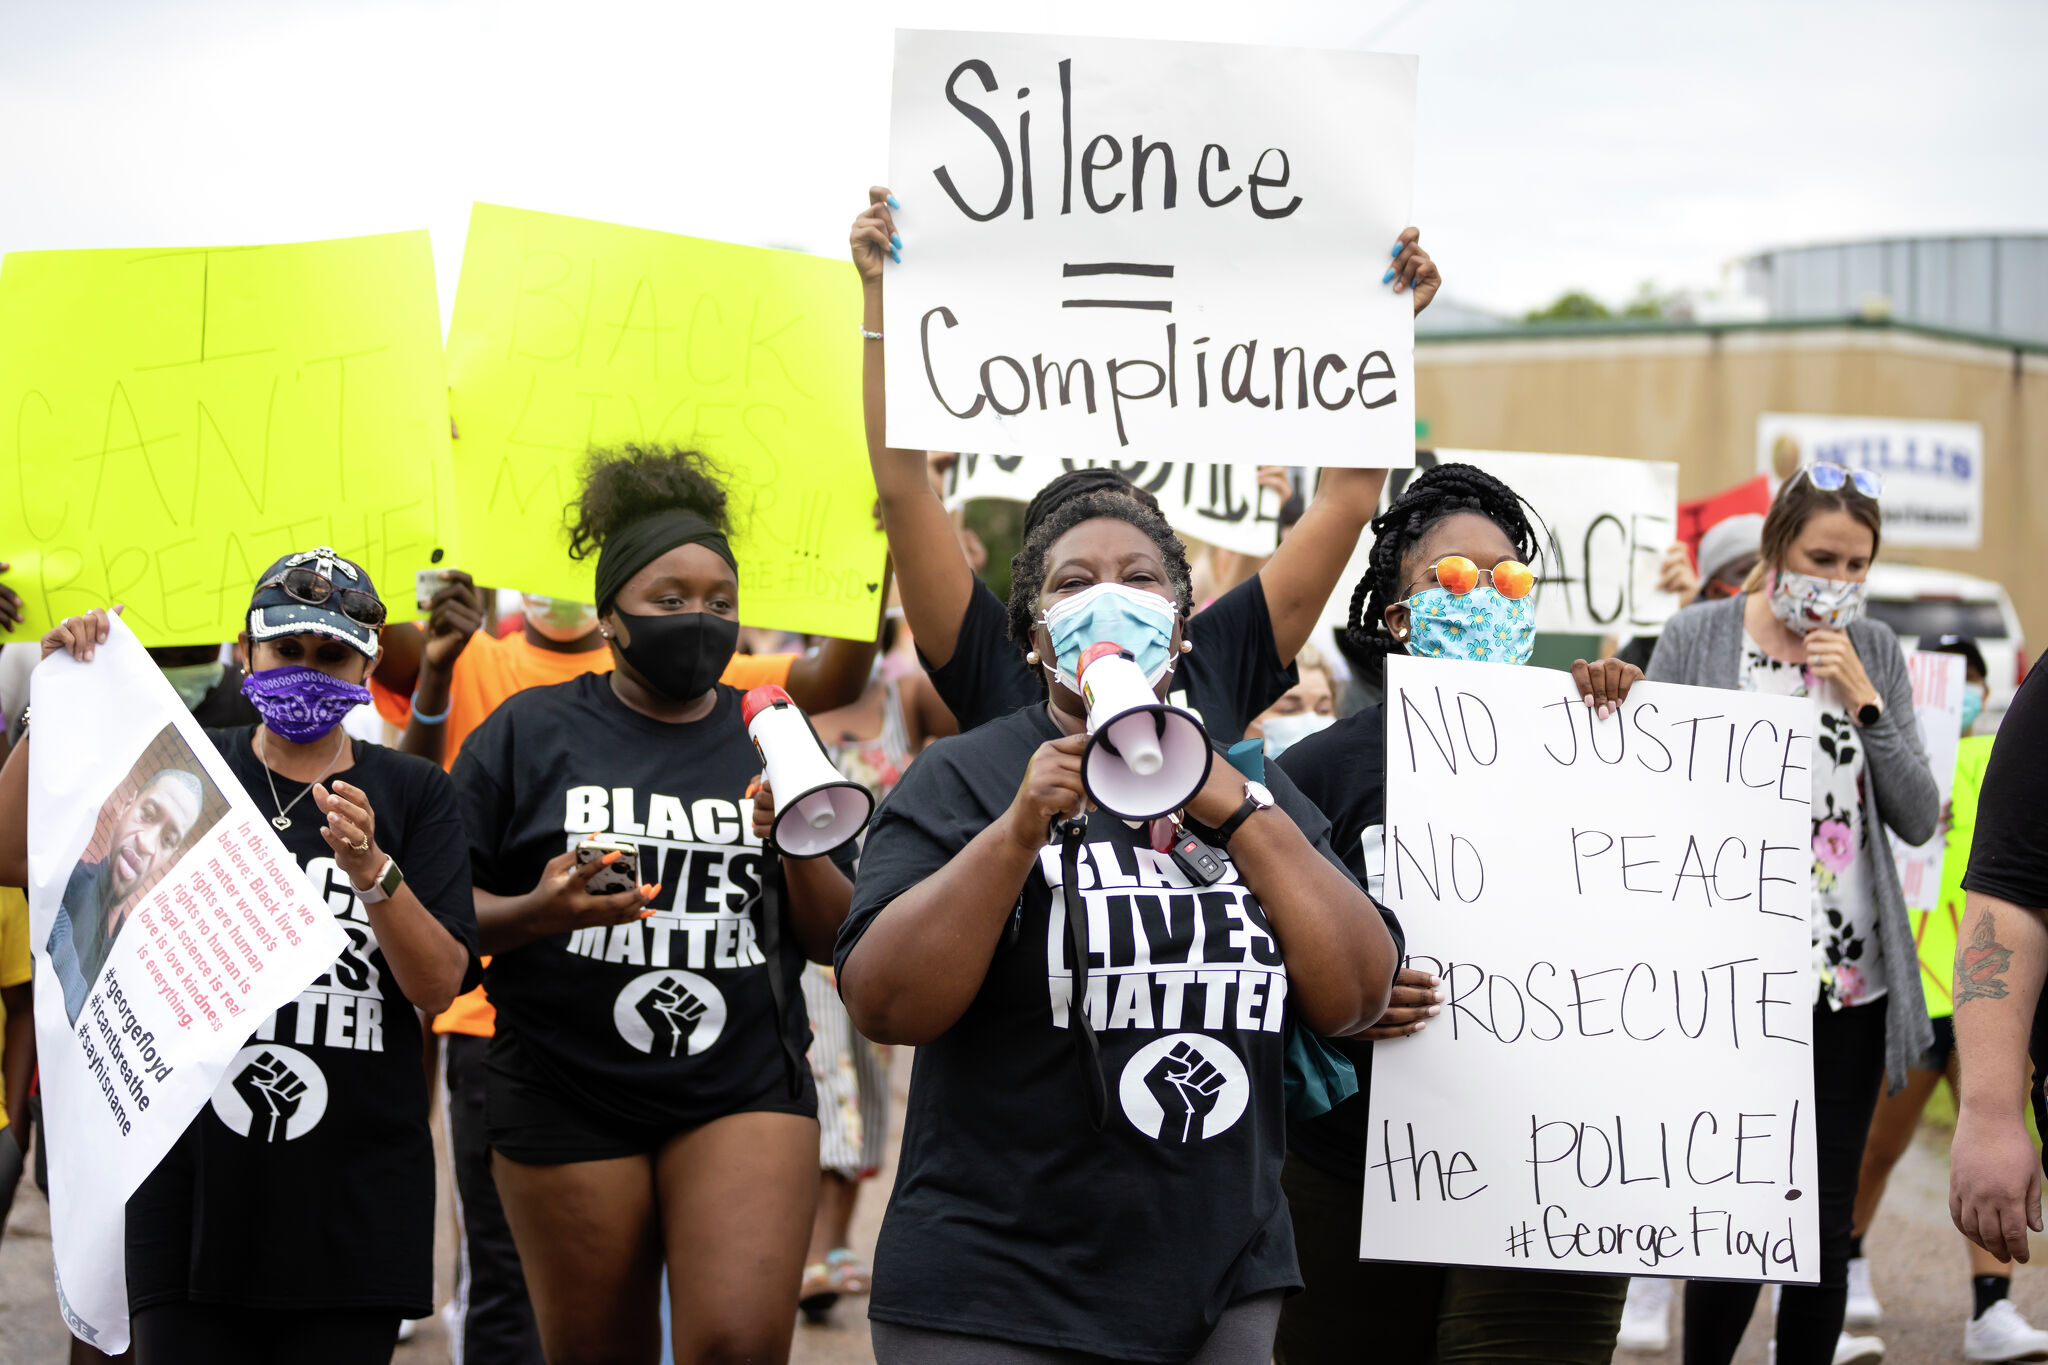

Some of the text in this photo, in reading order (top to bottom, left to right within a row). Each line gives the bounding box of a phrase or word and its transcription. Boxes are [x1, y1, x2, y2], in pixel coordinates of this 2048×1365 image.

[933, 58, 1303, 222] Silence
[126, 245, 276, 370] I
[921, 305, 1397, 447] Compliance
[16, 344, 390, 543] CAN'T
[1535, 513, 1672, 627] ACE
[1400, 685, 1811, 805] NO JUSTICE
[189, 870, 264, 974] rights are human
[207, 857, 278, 953] matter women's
[217, 830, 302, 947] believe: Black lives
[237, 821, 251, 838] In
[247, 834, 268, 862] this
[264, 858, 295, 899] house
[296, 904, 316, 926] we
[1394, 823, 1484, 904] NO
[1571, 827, 1805, 921] PEACE
[136, 942, 195, 1031] is everything.
[138, 907, 224, 1033] love is love kindness
[153, 890, 247, 1018] illegal science is real
[172, 882, 252, 995] rights no human is
[566, 918, 767, 969] MATTER
[77, 1021, 132, 1138] #sayhisname
[89, 992, 151, 1112] #icantbreathe
[103, 966, 174, 1084] #georgefloyd
[1370, 1099, 1803, 1205] the POLICE!
